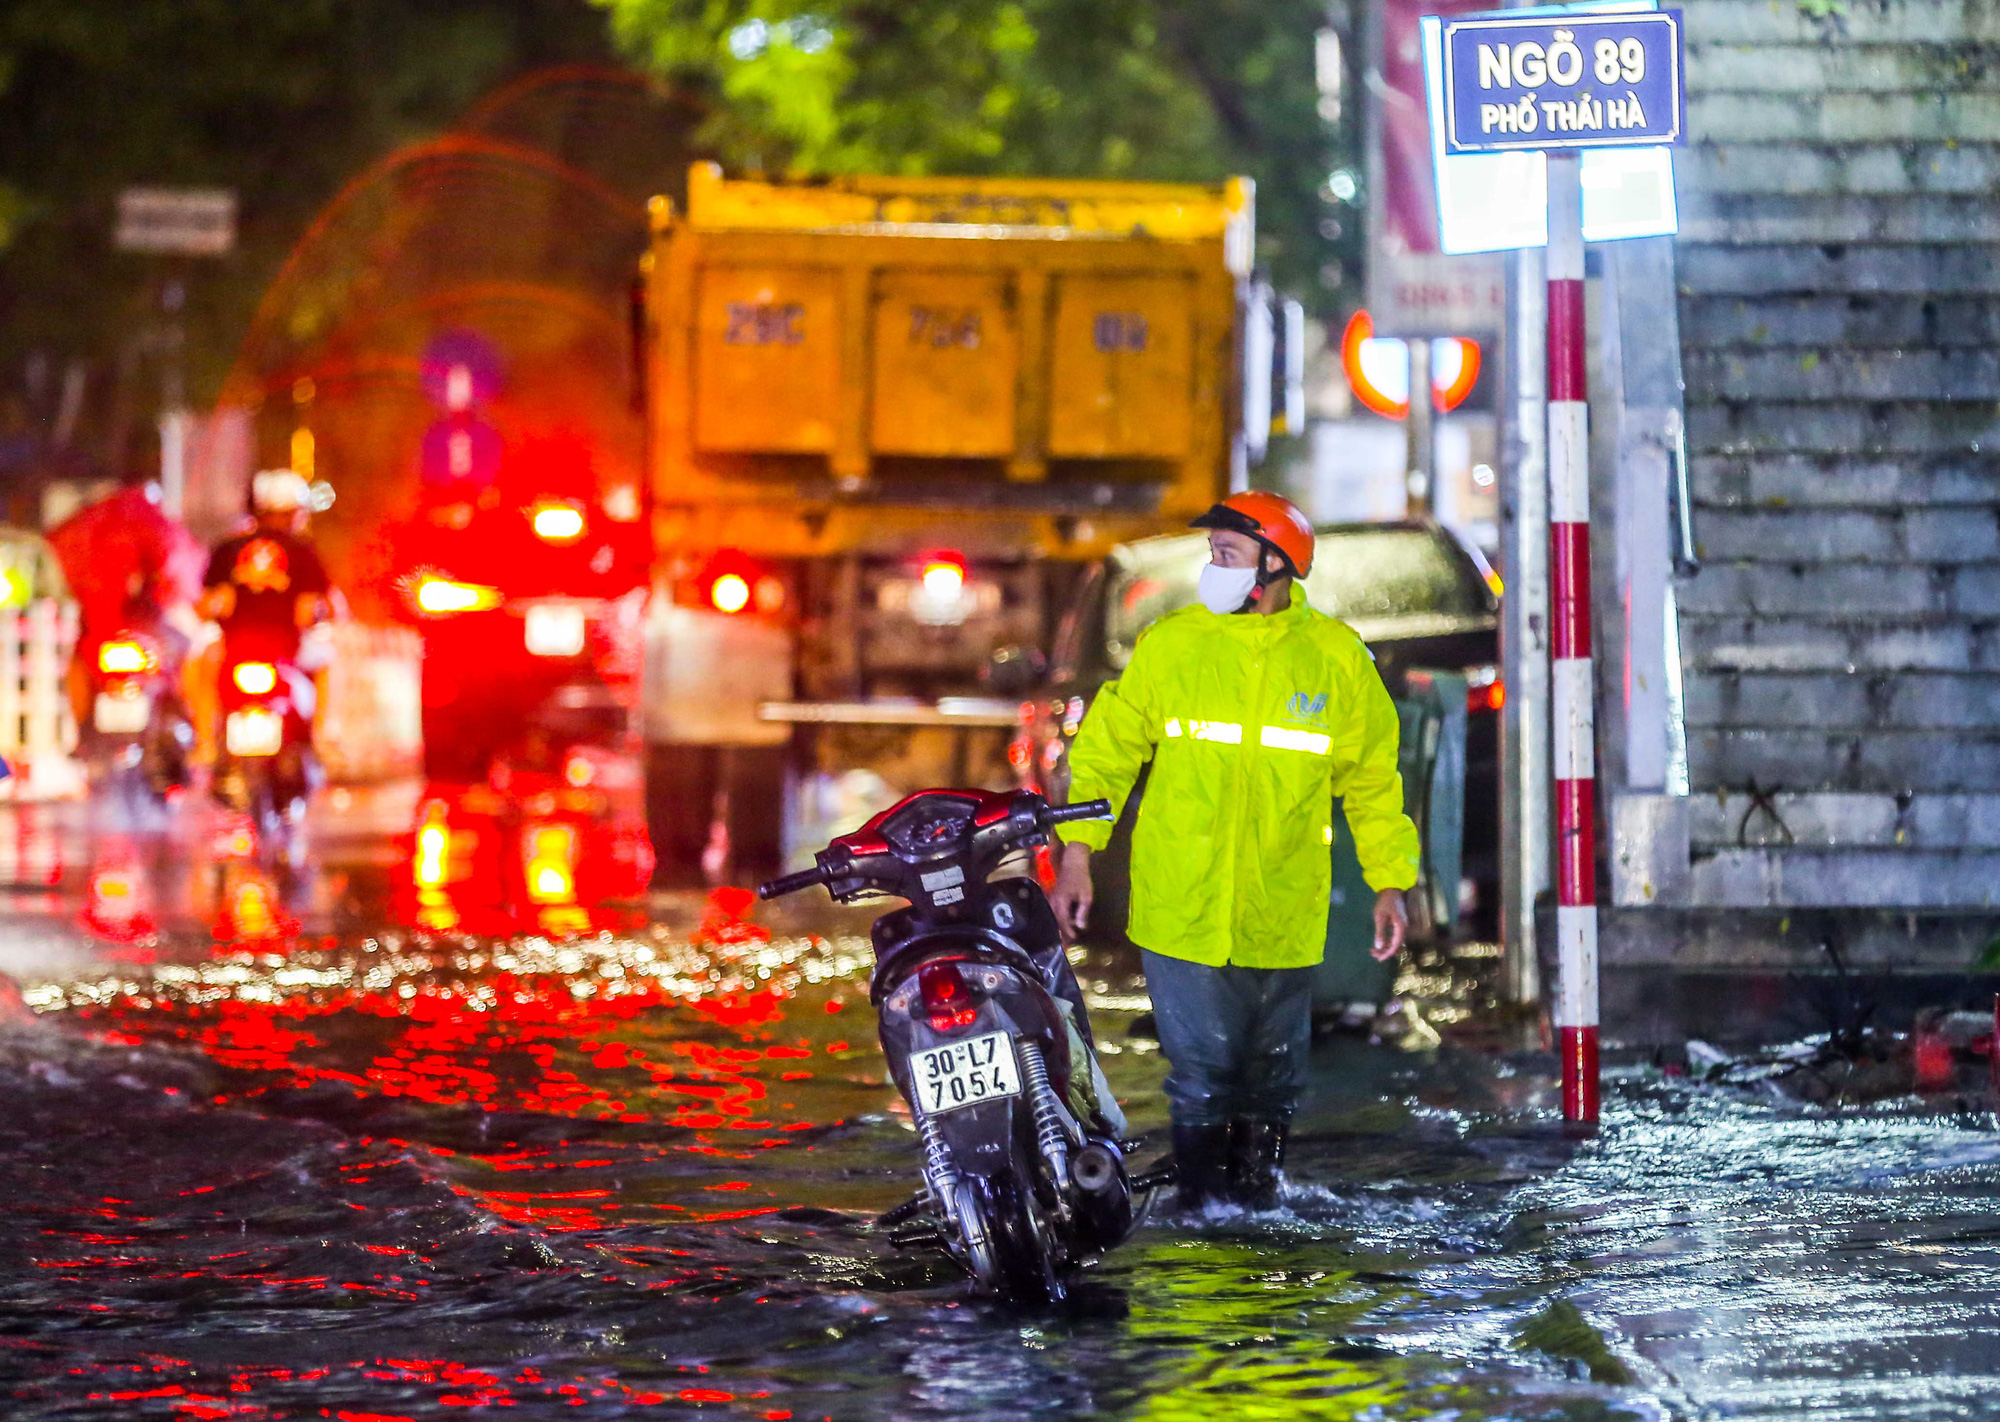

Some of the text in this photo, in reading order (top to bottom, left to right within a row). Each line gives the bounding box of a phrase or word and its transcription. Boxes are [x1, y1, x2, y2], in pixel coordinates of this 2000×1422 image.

[1478, 29, 1645, 89] NGÕ 89
[1481, 92, 1538, 134] PHỐ
[1607, 90, 1647, 130] HÀ
[930, 1068, 1006, 1109] 7054
